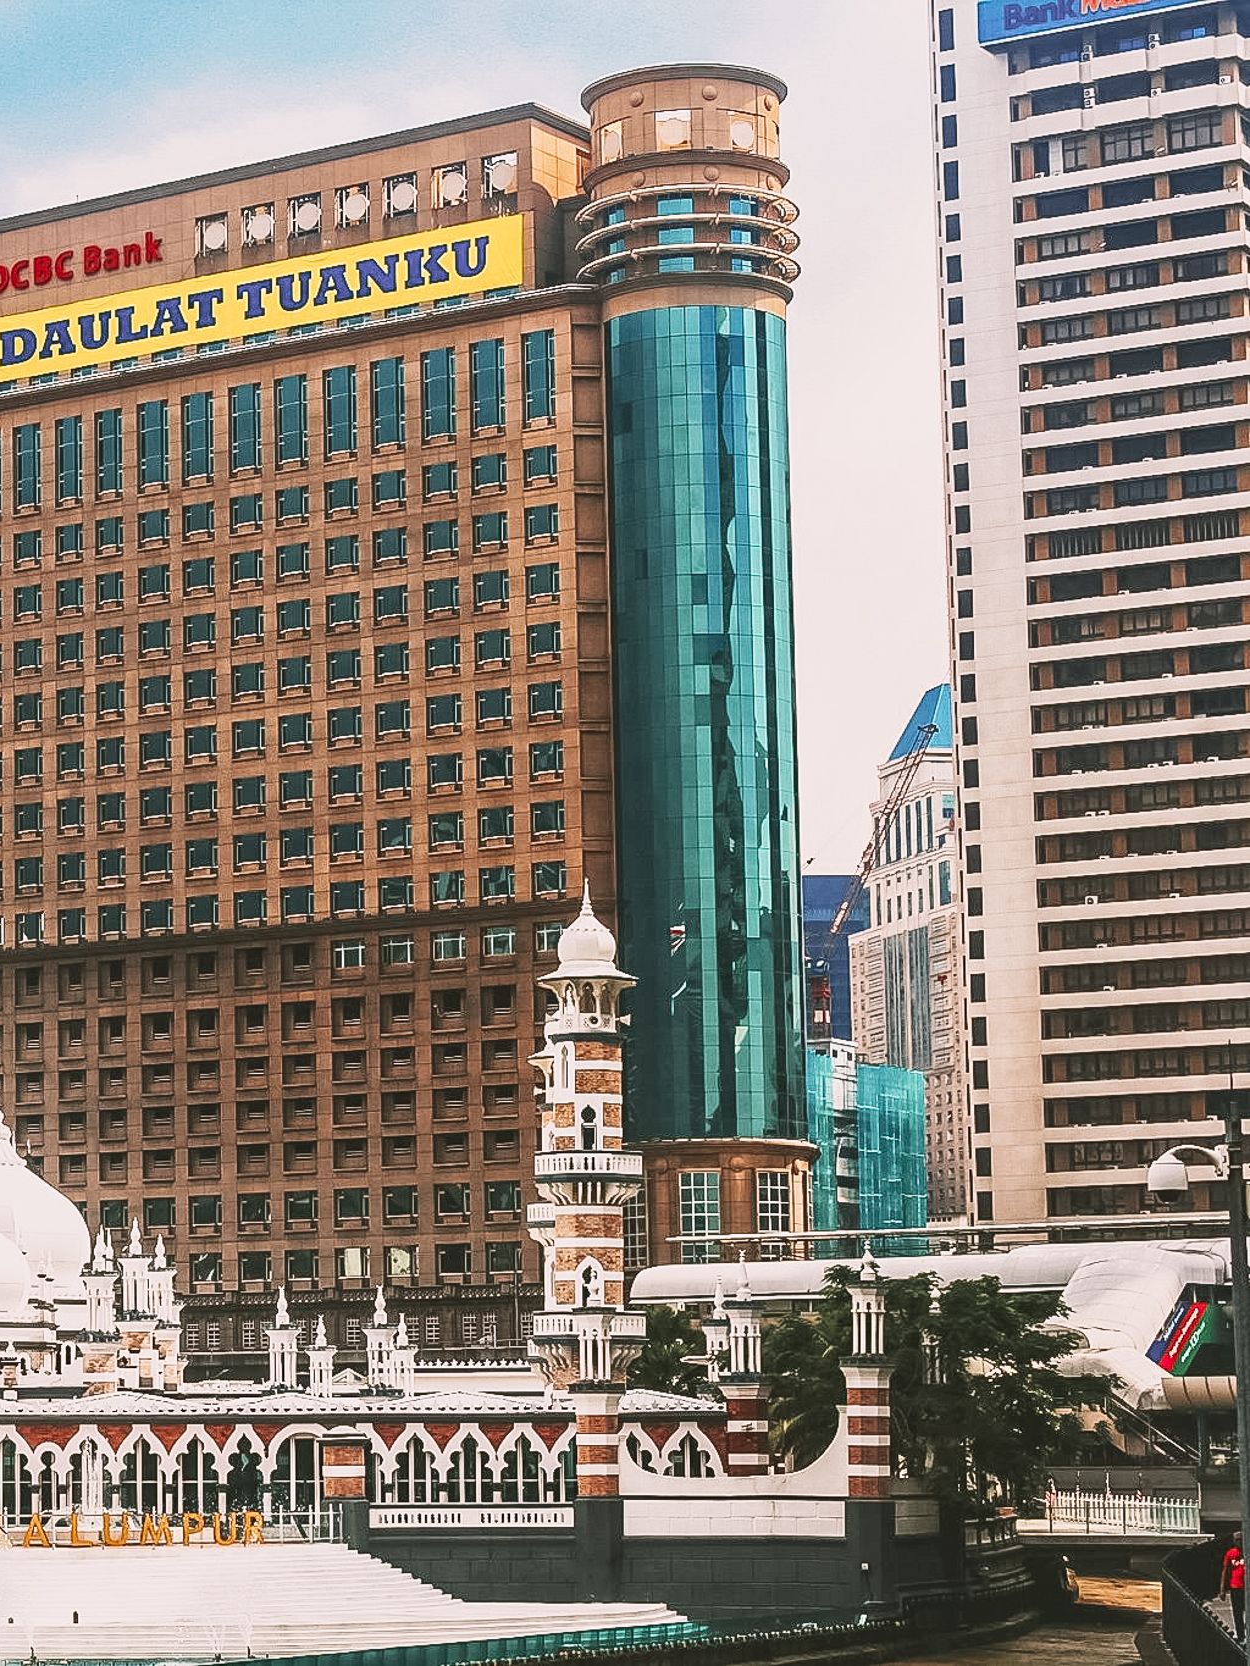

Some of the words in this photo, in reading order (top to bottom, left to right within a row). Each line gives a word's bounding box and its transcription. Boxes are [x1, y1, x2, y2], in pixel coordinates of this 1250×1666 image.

[1004, 0, 1078, 30] Bank
[83, 231, 163, 276] Bank
[0, 288, 224, 367] DAULAT
[237, 235, 490, 320] TUANKU
[70, 1511, 265, 1548] LUMPUR
